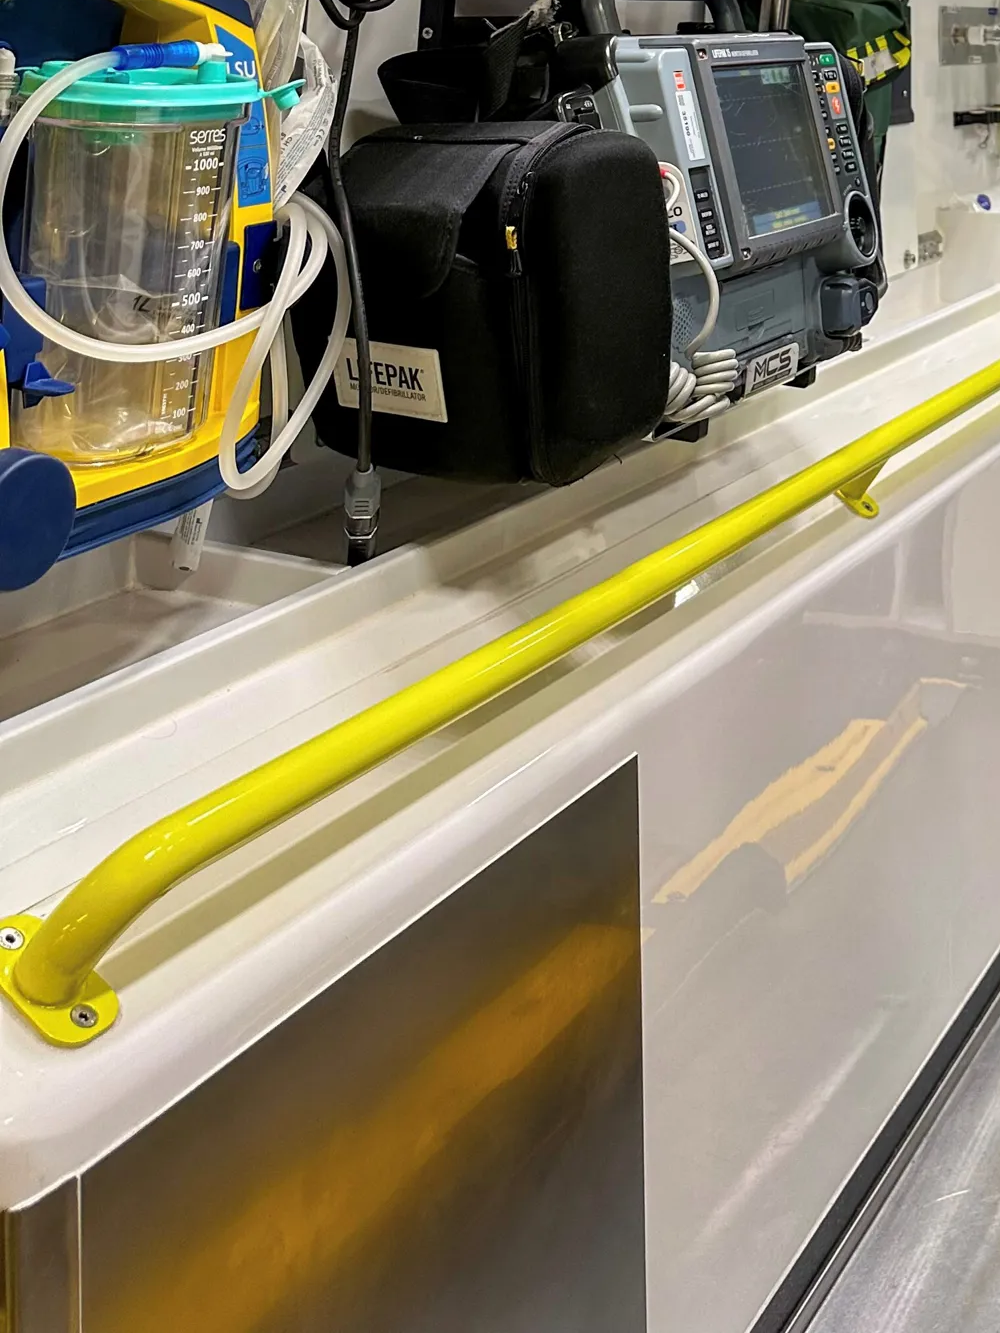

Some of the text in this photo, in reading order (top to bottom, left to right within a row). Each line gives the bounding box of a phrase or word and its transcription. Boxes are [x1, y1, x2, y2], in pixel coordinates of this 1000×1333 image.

[192, 157, 219, 171] 1000
[195, 185, 211, 196] 900
[193, 212, 208, 223] 800
[190, 240, 205, 251] 700
[187, 268, 202, 278] 600
[181, 293, 201, 307] 500
[180, 324, 195, 335] 400
[753, 347, 792, 383] MCS
[346, 357, 424, 392] LEPAK
[174, 379, 189, 391] 200
[172, 407, 186, 419] 100
